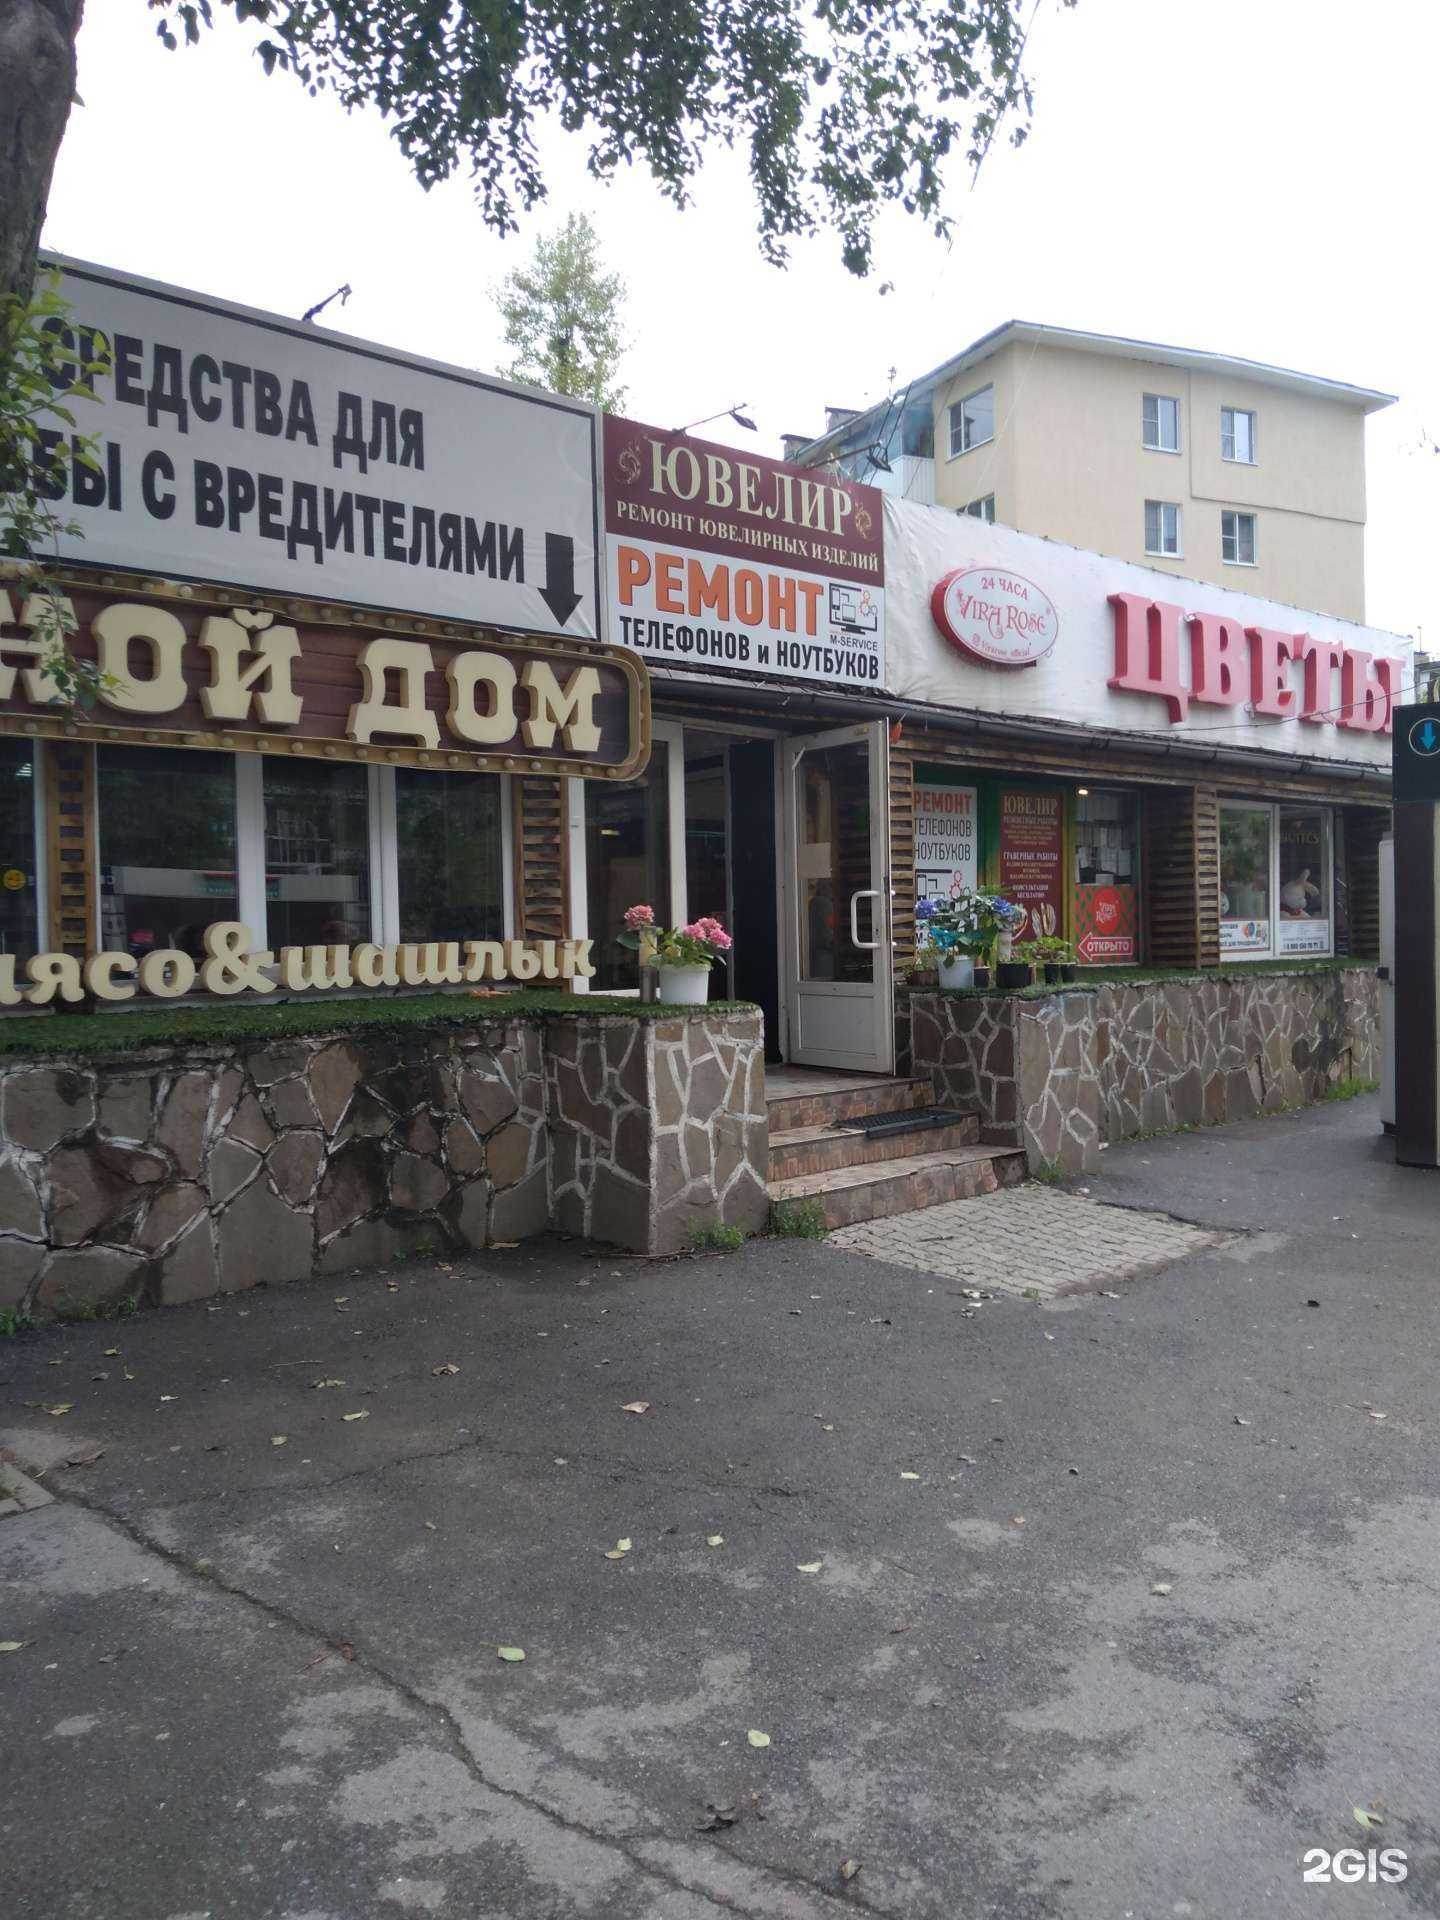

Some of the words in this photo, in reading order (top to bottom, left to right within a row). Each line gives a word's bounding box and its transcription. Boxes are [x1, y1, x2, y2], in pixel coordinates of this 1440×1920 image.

[41, 317, 318, 446] СРЕДСТВА
[333, 391, 425, 474] ДЛЯ
[142, 449, 176, 520] С
[193, 458, 525, 584] ВРЕДИТЕЛЯМИ
[648, 438, 852, 536] ЮВЕЛИР
[616, 500, 695, 533] РЕМОНТ
[699, 518, 809, 558] ЮВЕЛИРНЫХ
[812, 543, 879, 573] ИЗДЕЛИЙ
[617, 544, 824, 636] РЕМОНТ
[981, 577, 995, 590] 24
[999, 578, 1027, 600] ЧАСА
[619, 615, 750, 661] ТЕЛЕФОНОВ
[776, 640, 879, 680] НОУТБУКОВ
[829, 634, 878, 651] M-SERVICE
[1107, 592, 1405, 733] ЦВЕТЫ
[346, 638, 602, 753] ДОМ
[913, 790, 972, 815] РЕМОНТ
[1003, 795, 1057, 815] ЮВЕЛИР
[1086, 941, 1129, 952] ОТКРЫТО
